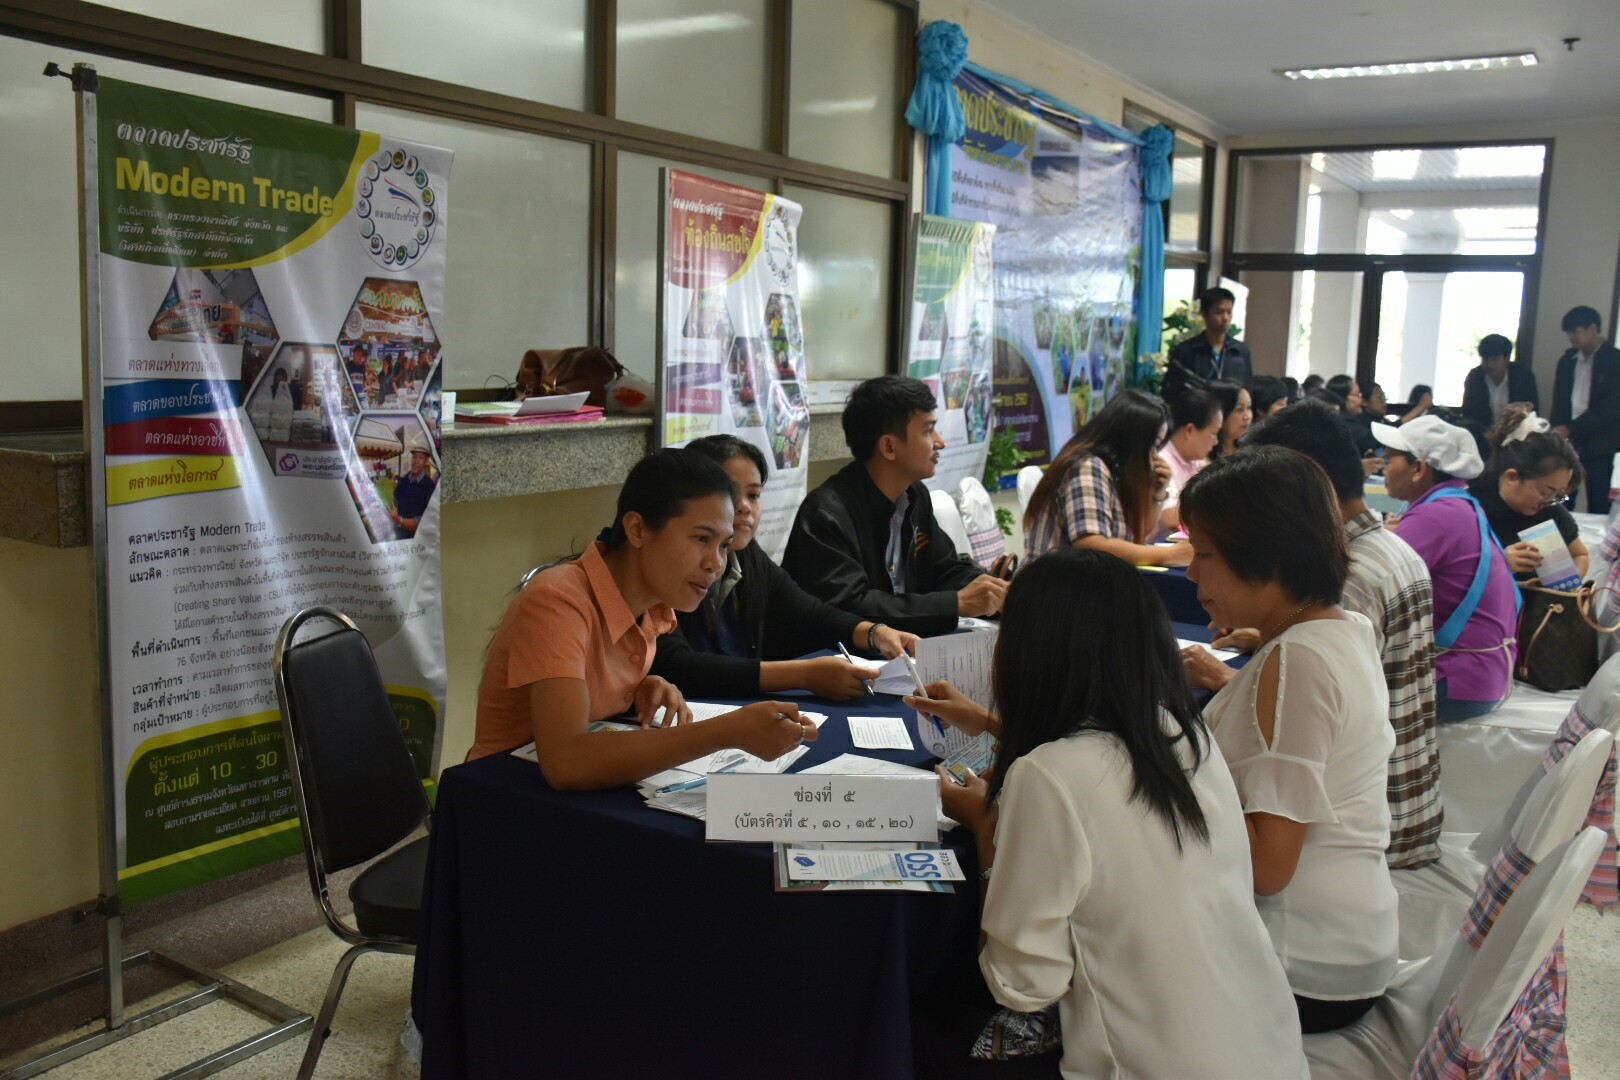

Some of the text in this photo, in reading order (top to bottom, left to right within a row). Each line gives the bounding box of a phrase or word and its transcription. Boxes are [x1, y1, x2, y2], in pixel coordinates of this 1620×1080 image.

[117, 122, 252, 164] ตลาดประชารัฐ
[116, 157, 334, 217] Modern Trade
[129, 458, 224, 491] ตลาดแห่งโอกาส
[128, 520, 267, 546] ตลาดประชารัฐ Modern Trade
[129, 547, 190, 565] ลักษณะตลาด
[129, 566, 162, 583] แนวคิด
[172, 559, 236, 577] กระทรวงพาณิชย์
[239, 557, 262, 570] จังหวัด
[174, 600, 210, 614] (Creating
[212, 596, 236, 608] Share
[239, 594, 262, 606] Value
[131, 634, 201, 659] พื้นที่ดำเนินการ
[176, 656, 187, 668] 76
[189, 650, 217, 665] จังหวัด
[132, 676, 183, 696] เวลาทำการ
[133, 689, 201, 714] สินค้าที่จำหน่าย
[133, 710, 194, 733] กลุ่มเป้าหมาย
[154, 768, 200, 797] ตั้งแต่
[209, 761, 231, 781] 10
[255, 751, 277, 770] 30
[272, 786, 292, 799] 1567
[794, 782, 856, 803] ช่องที่ ๕
[734, 809, 793, 830] (บัตรคิวที่
[797, 816, 808, 829] ๕
[821, 818, 841, 829] ๑๐
[855, 816, 876, 829] ๑๕
[888, 815, 914, 830] ๒๐)
[904, 851, 942, 879] OSS
